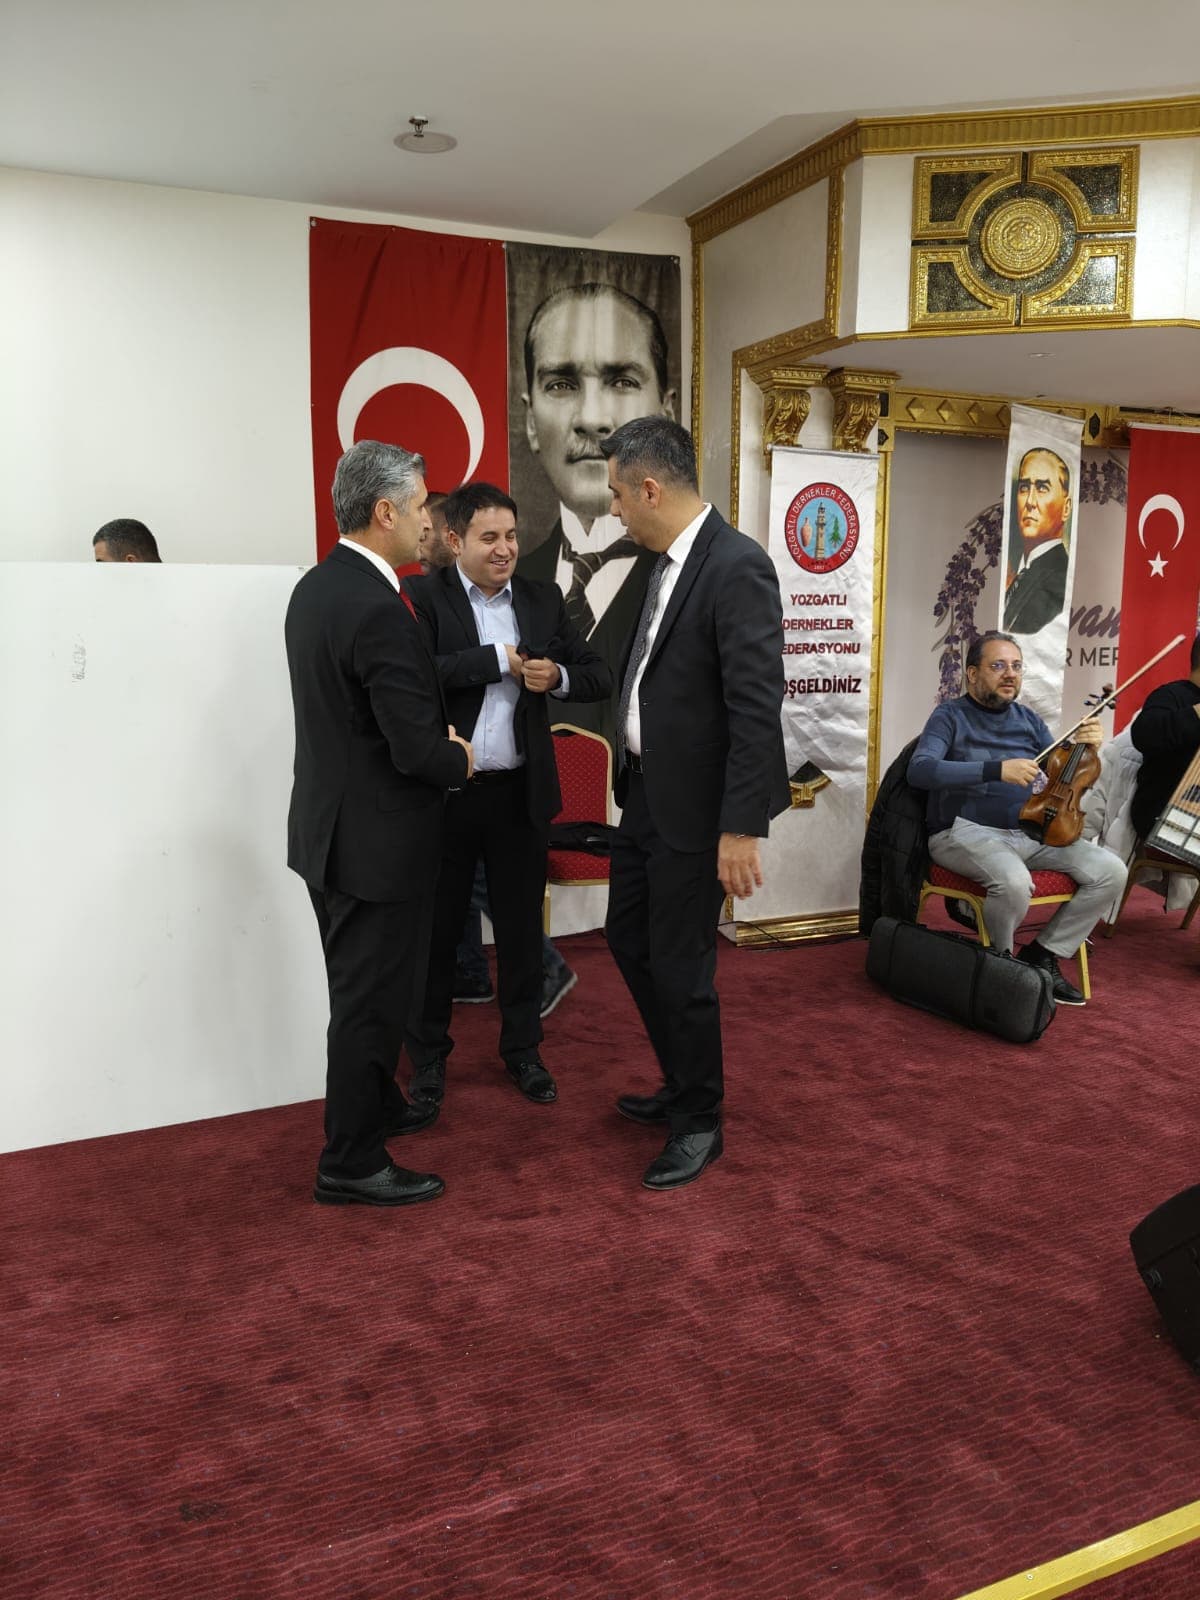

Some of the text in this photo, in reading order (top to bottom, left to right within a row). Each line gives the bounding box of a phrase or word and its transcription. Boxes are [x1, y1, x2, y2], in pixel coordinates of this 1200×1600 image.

[787, 487, 857, 560] YOZGATLI DERNEKLER FEDERASYONU
[790, 594, 847, 606] YOZGATLI
[782, 618, 854, 631] DERNEKLER
[781, 643, 861, 655] EDERASYONU
